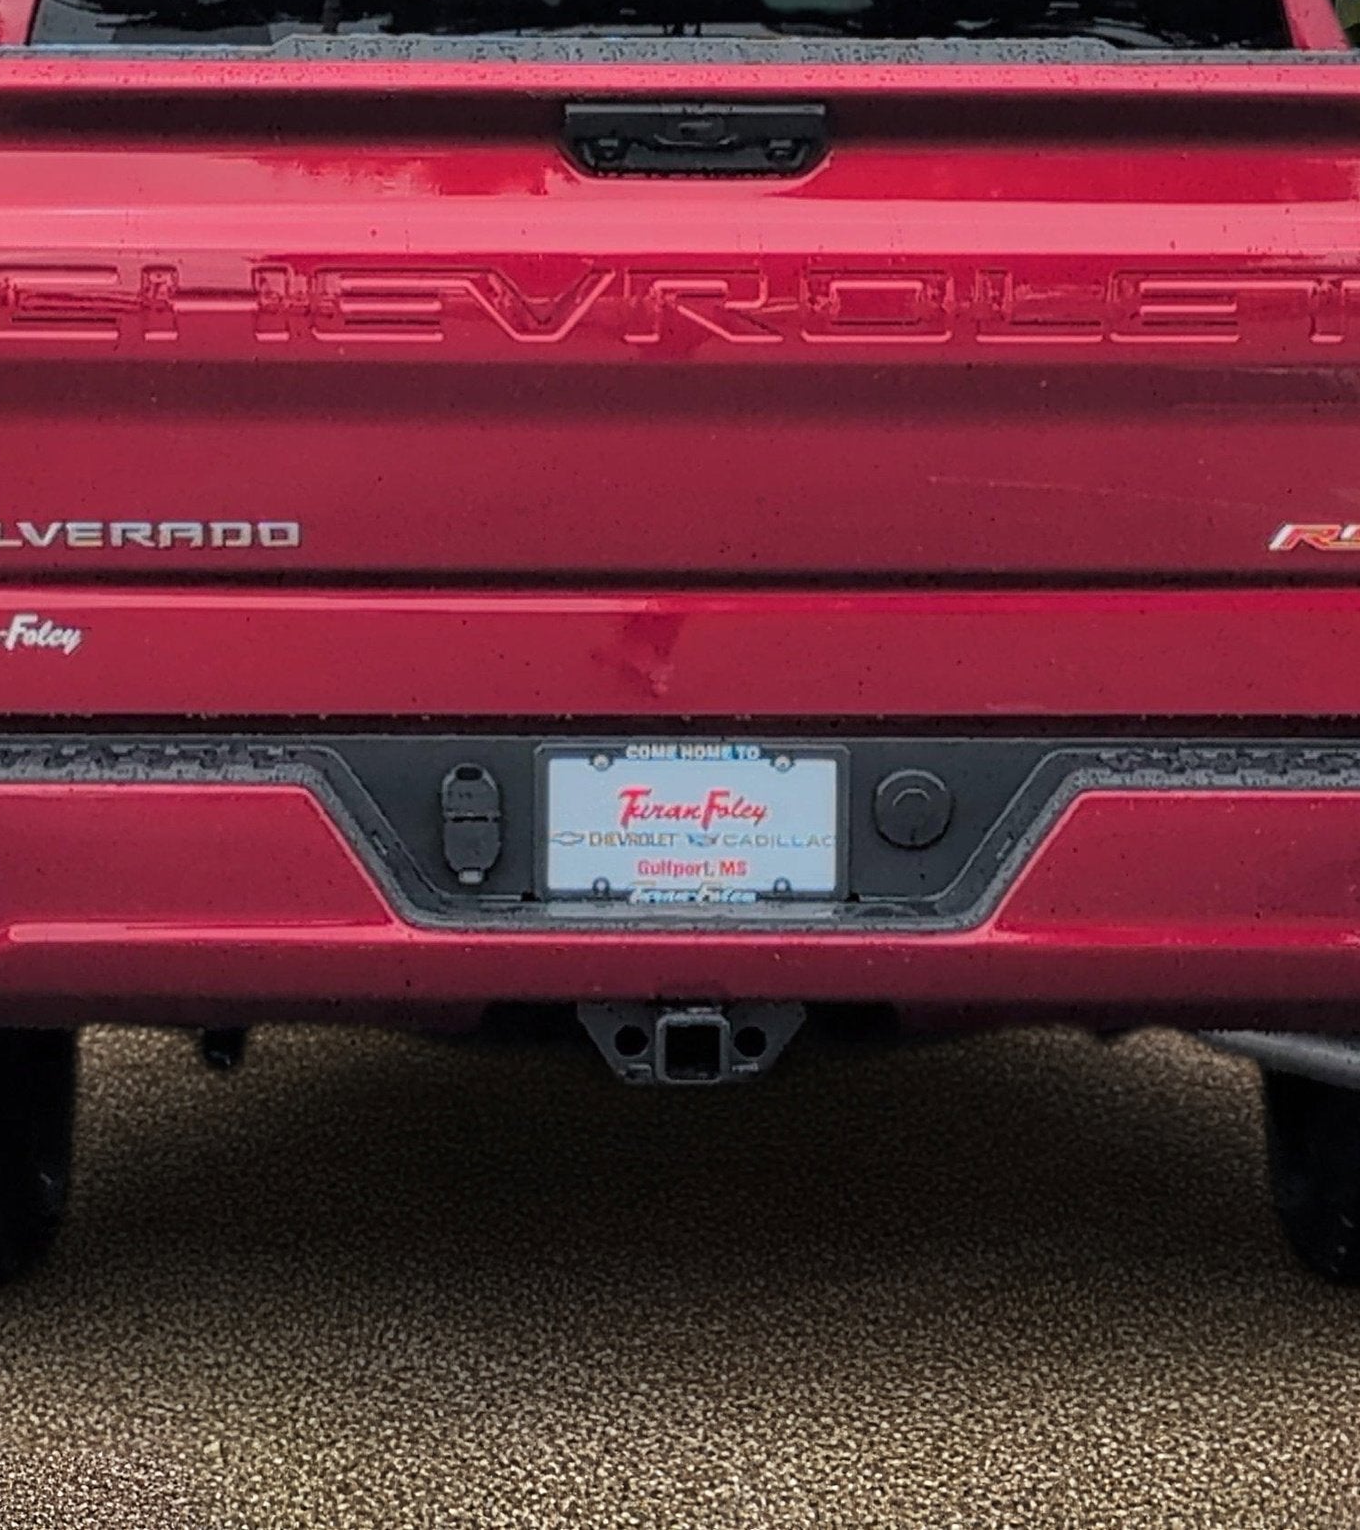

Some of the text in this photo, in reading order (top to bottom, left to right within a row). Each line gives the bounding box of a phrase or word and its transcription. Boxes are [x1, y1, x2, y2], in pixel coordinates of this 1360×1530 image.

[625, 742, 760, 760] COME HOME TO
[589, 831, 836, 848] CHEVROLET CADILLAC
[719, 859, 748, 876] MS
